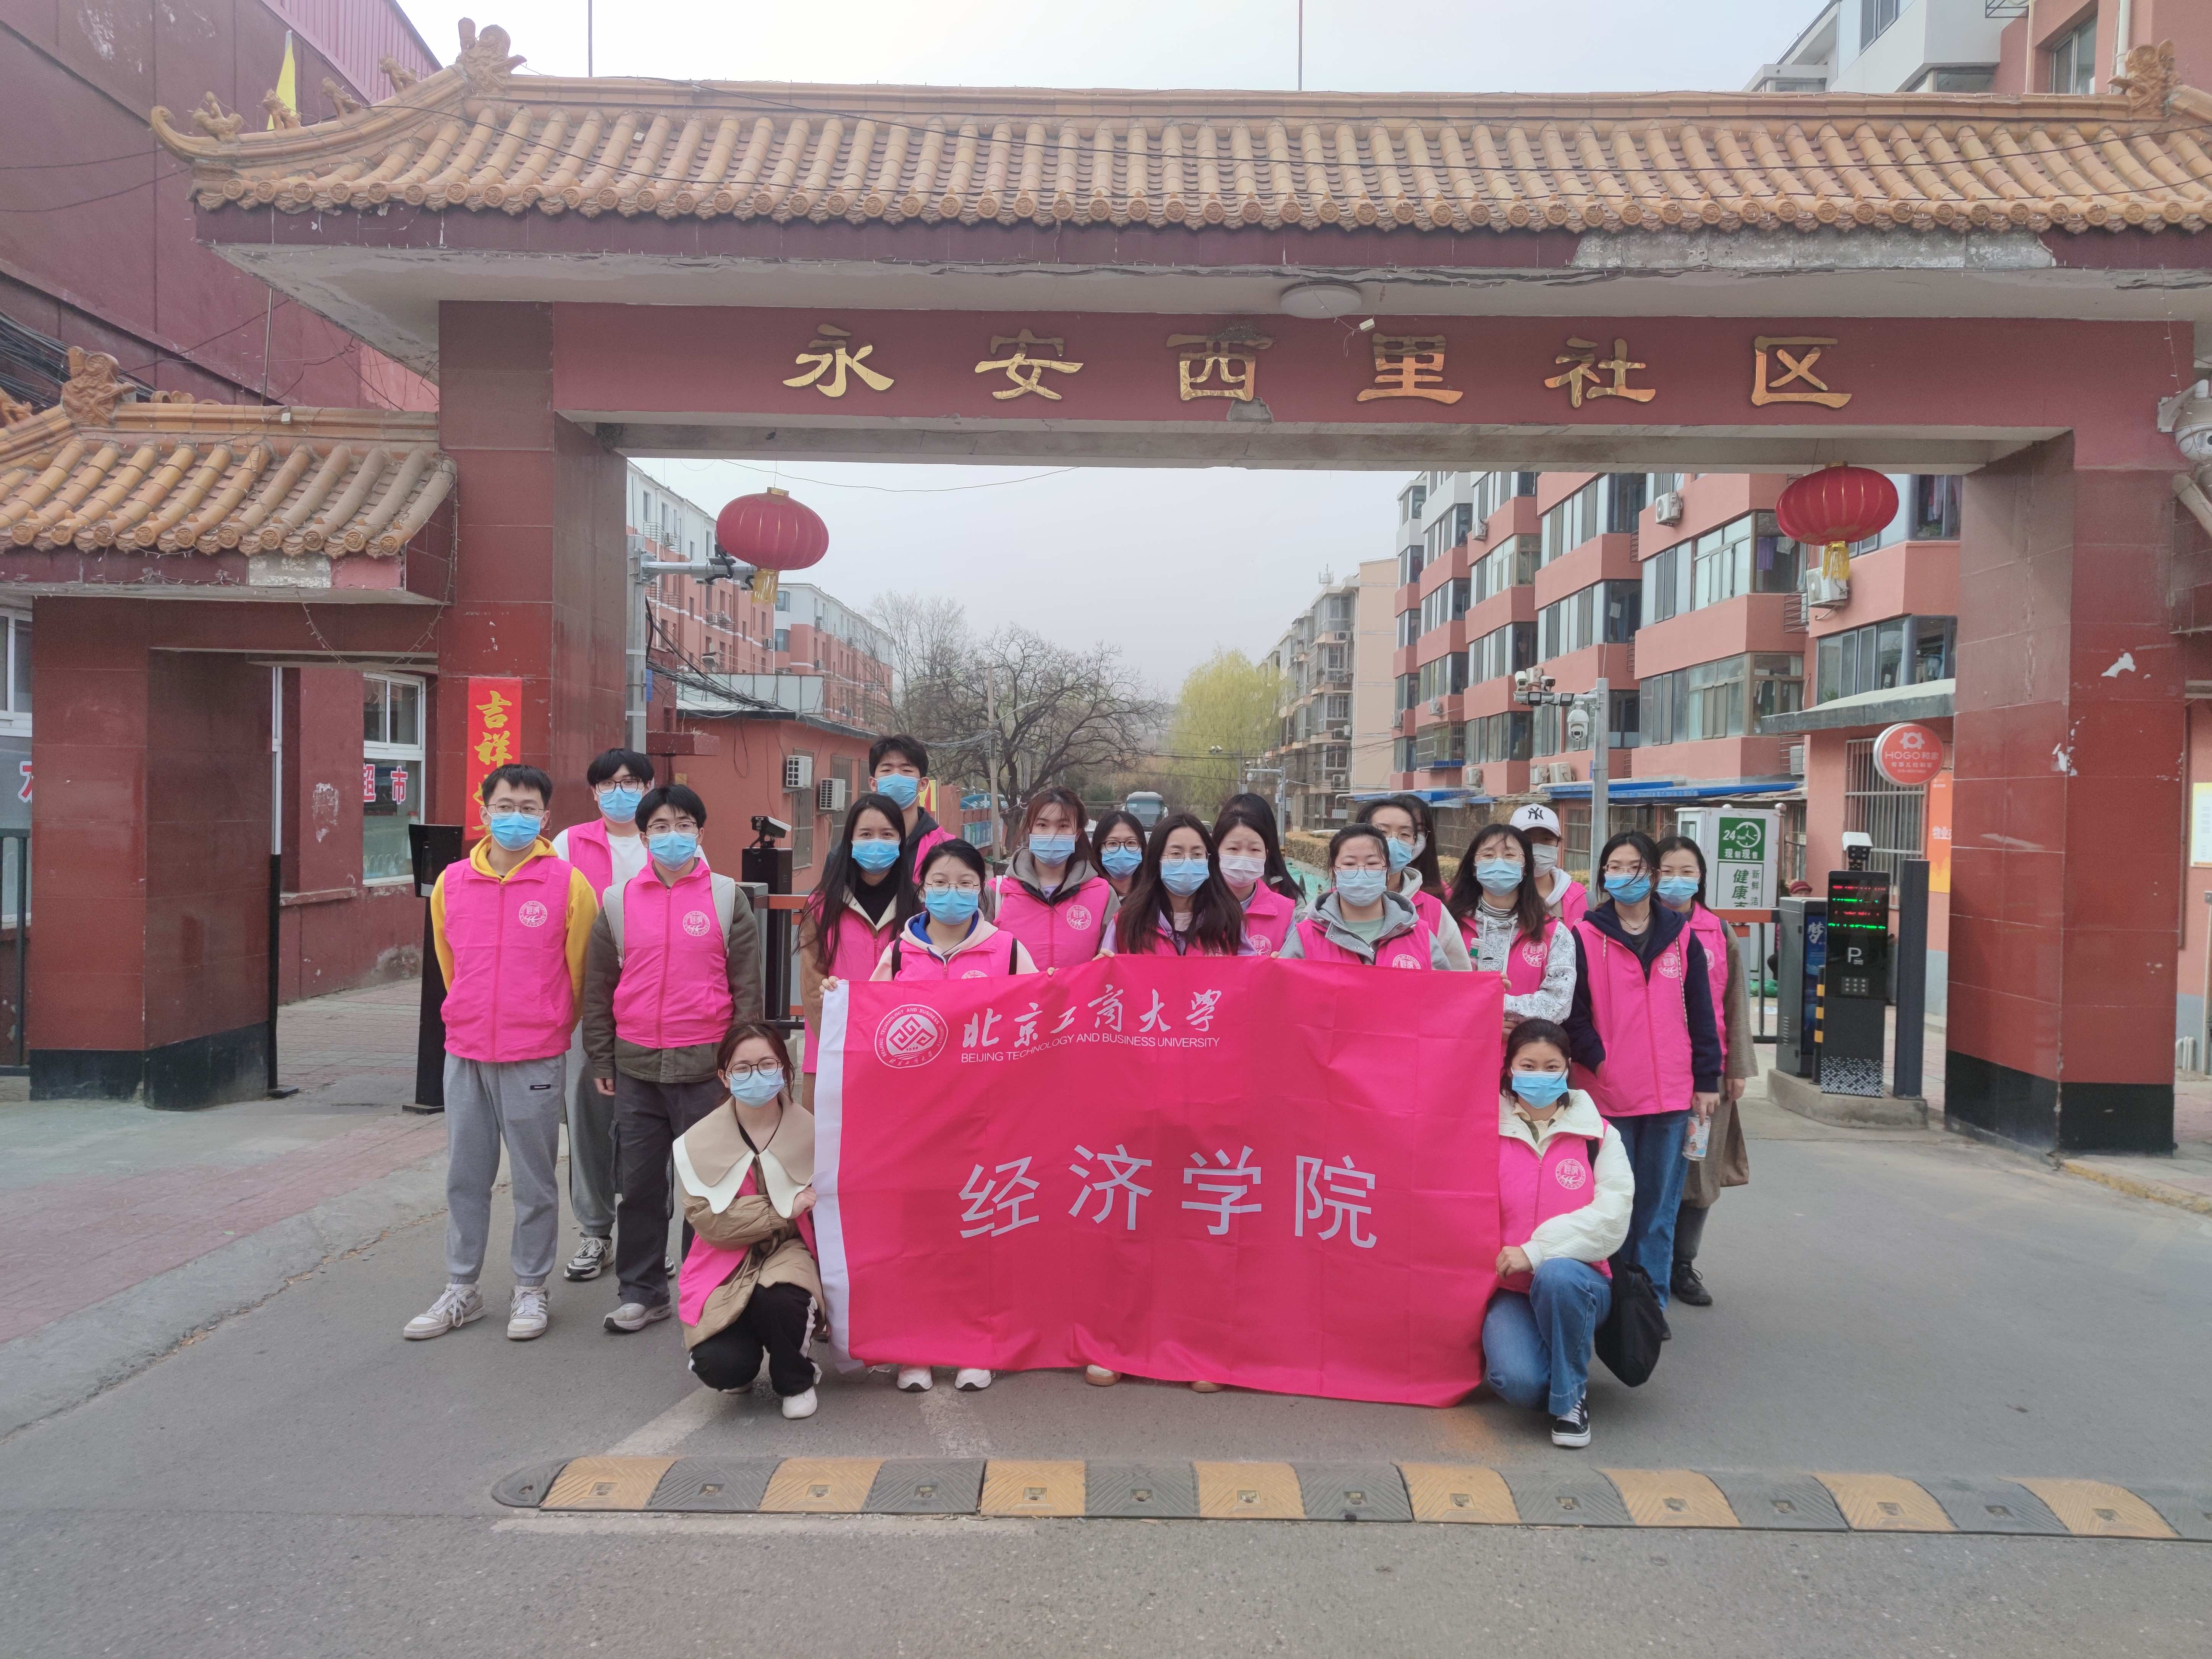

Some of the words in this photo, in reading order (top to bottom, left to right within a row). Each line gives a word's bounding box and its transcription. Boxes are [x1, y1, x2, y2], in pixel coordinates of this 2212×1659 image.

[783, 324, 1852, 408] 永安西里社区
[472, 690, 513, 835] 吉祥
[1528, 807, 1544, 820] NY
[1723, 830, 1736, 841] 24
[1847, 947, 1862, 962] P
[880, 1009, 904, 1035] TECHNOLOGY
[919, 1008, 940, 1025] BUSINESS
[879, 1038, 887, 1057] BEIJING
[961, 1052, 1004, 1062] BEIJING
[1006, 1034, 1075, 1061] TECHNOLOGY
[1076, 1033, 1100, 1043] AND
[1102, 1033, 1156, 1047] BUSINESS
[1158, 1037, 1220, 1048] UNIVERSITY
[958, 1144, 1377, 1248] 经济学院
